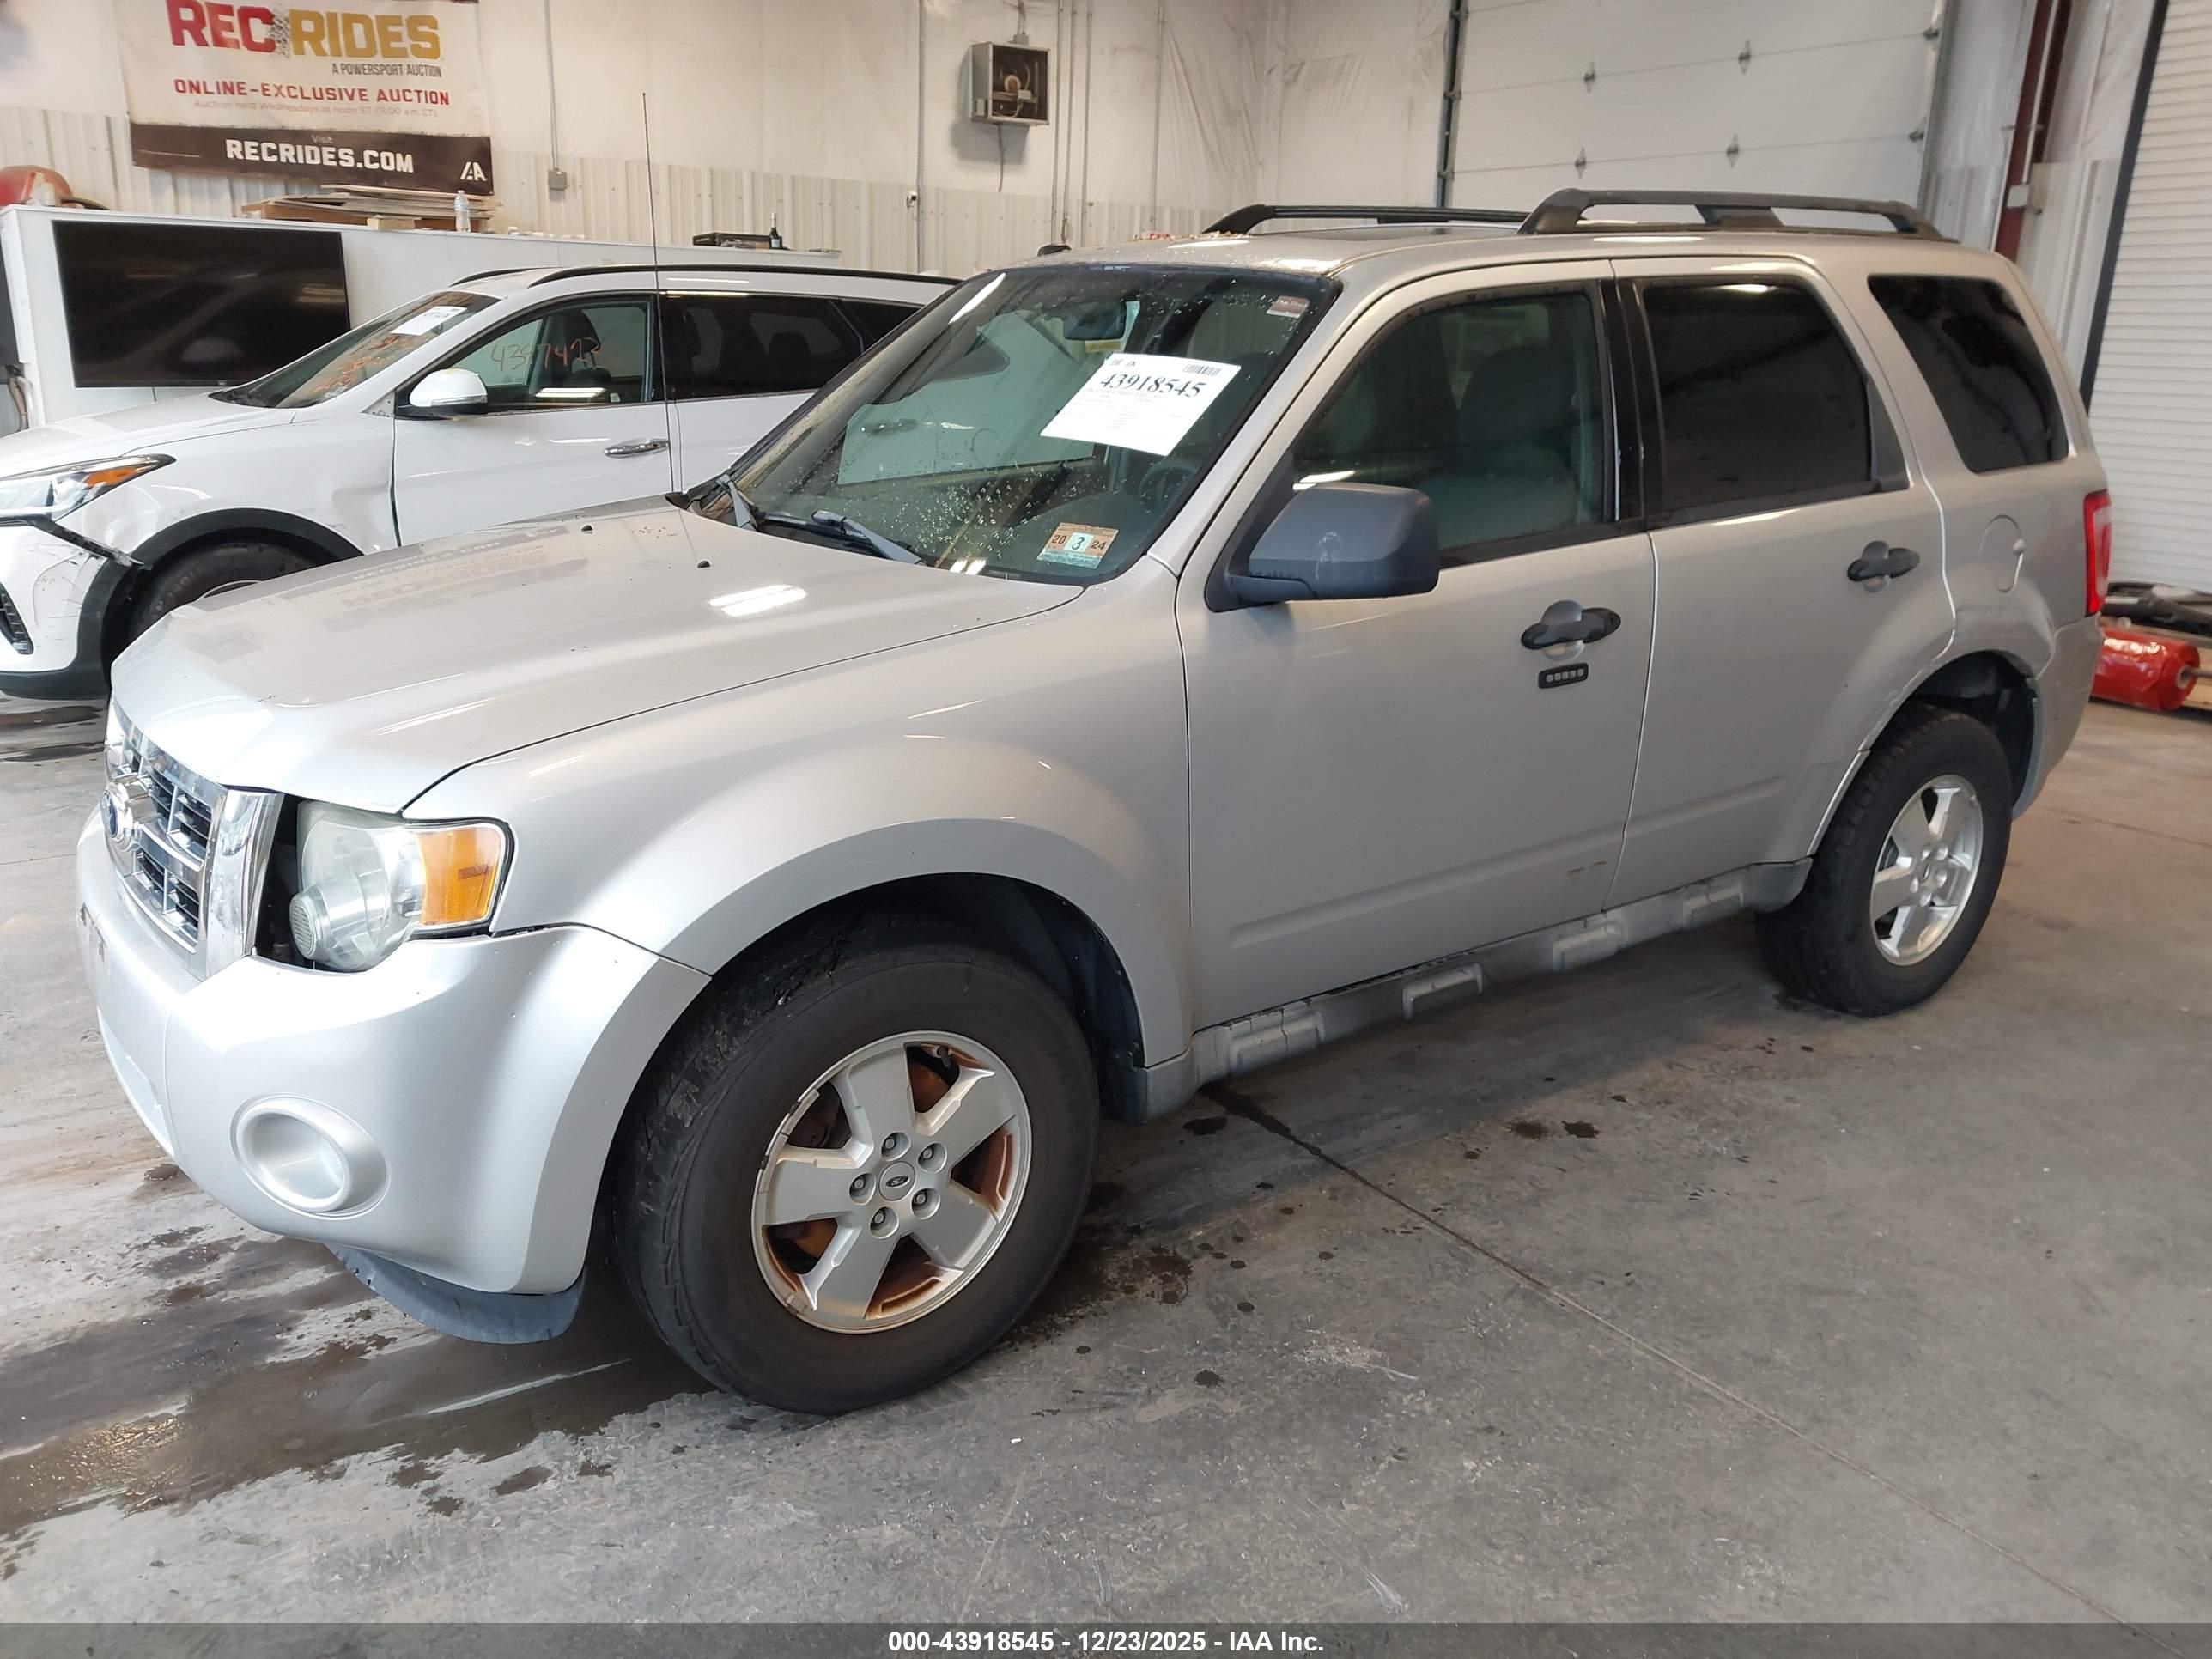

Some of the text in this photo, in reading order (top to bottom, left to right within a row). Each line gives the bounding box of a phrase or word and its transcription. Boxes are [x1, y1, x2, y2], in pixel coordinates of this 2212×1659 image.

[167, 0, 441, 59] REC RIDES
[331, 63, 442, 77] A POWERSPORT AUCTION
[173, 79, 450, 106] ONLINE-EXCLUSIVE AUCTION
[225, 138, 414, 173] RECRIDES.COM
[1100, 373, 1206, 398] 43918545
[1050, 534, 1107, 550] 20 3 24
